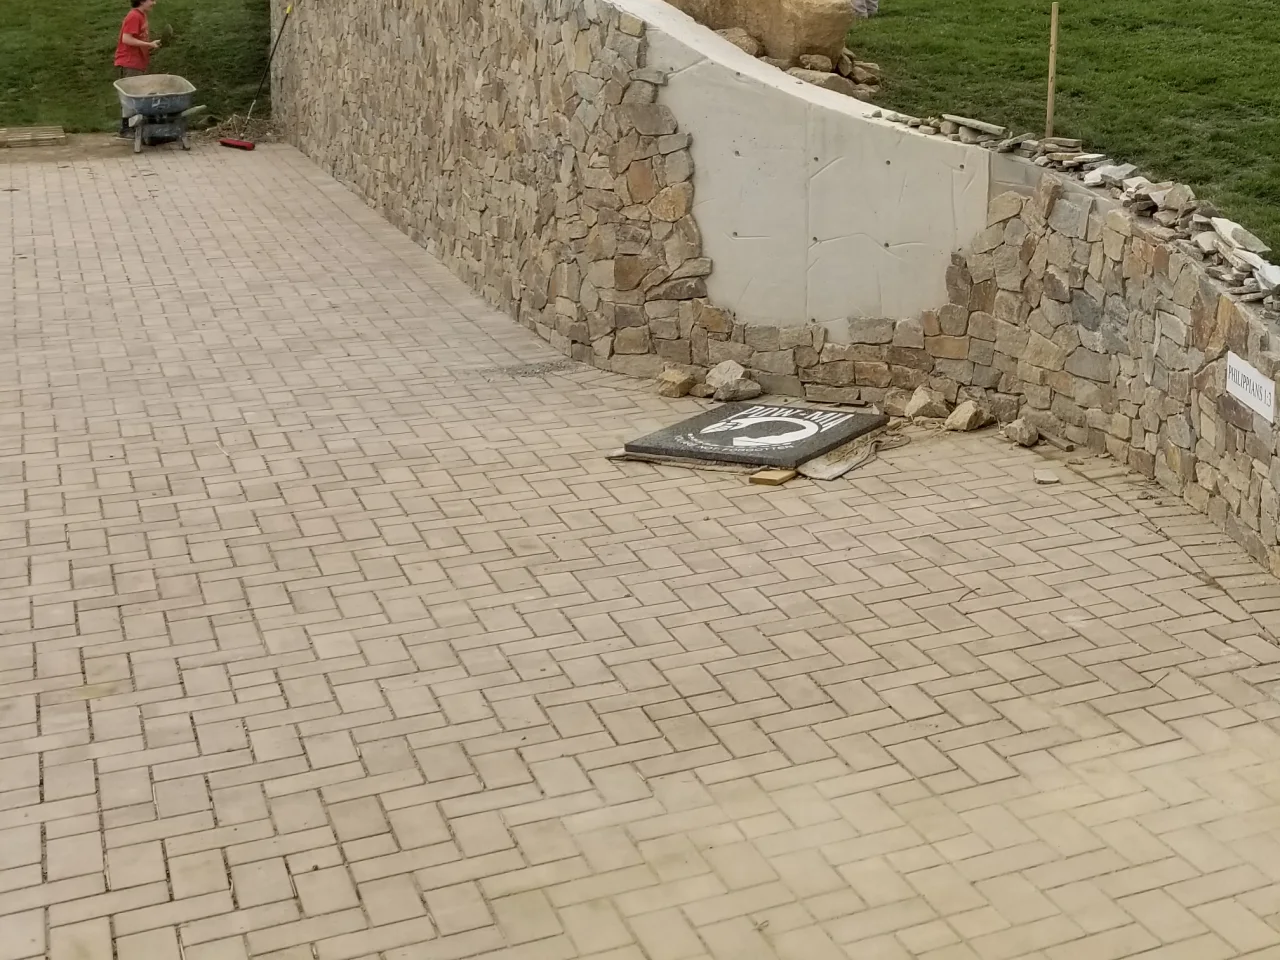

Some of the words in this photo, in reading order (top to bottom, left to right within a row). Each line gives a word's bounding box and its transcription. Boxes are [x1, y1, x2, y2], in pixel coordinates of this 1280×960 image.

[1228, 364, 1263, 401] PHILIPPIANS
[1264, 389, 1272, 407] 1:3
[720, 405, 804, 423] POW
[804, 410, 855, 433] MIA
